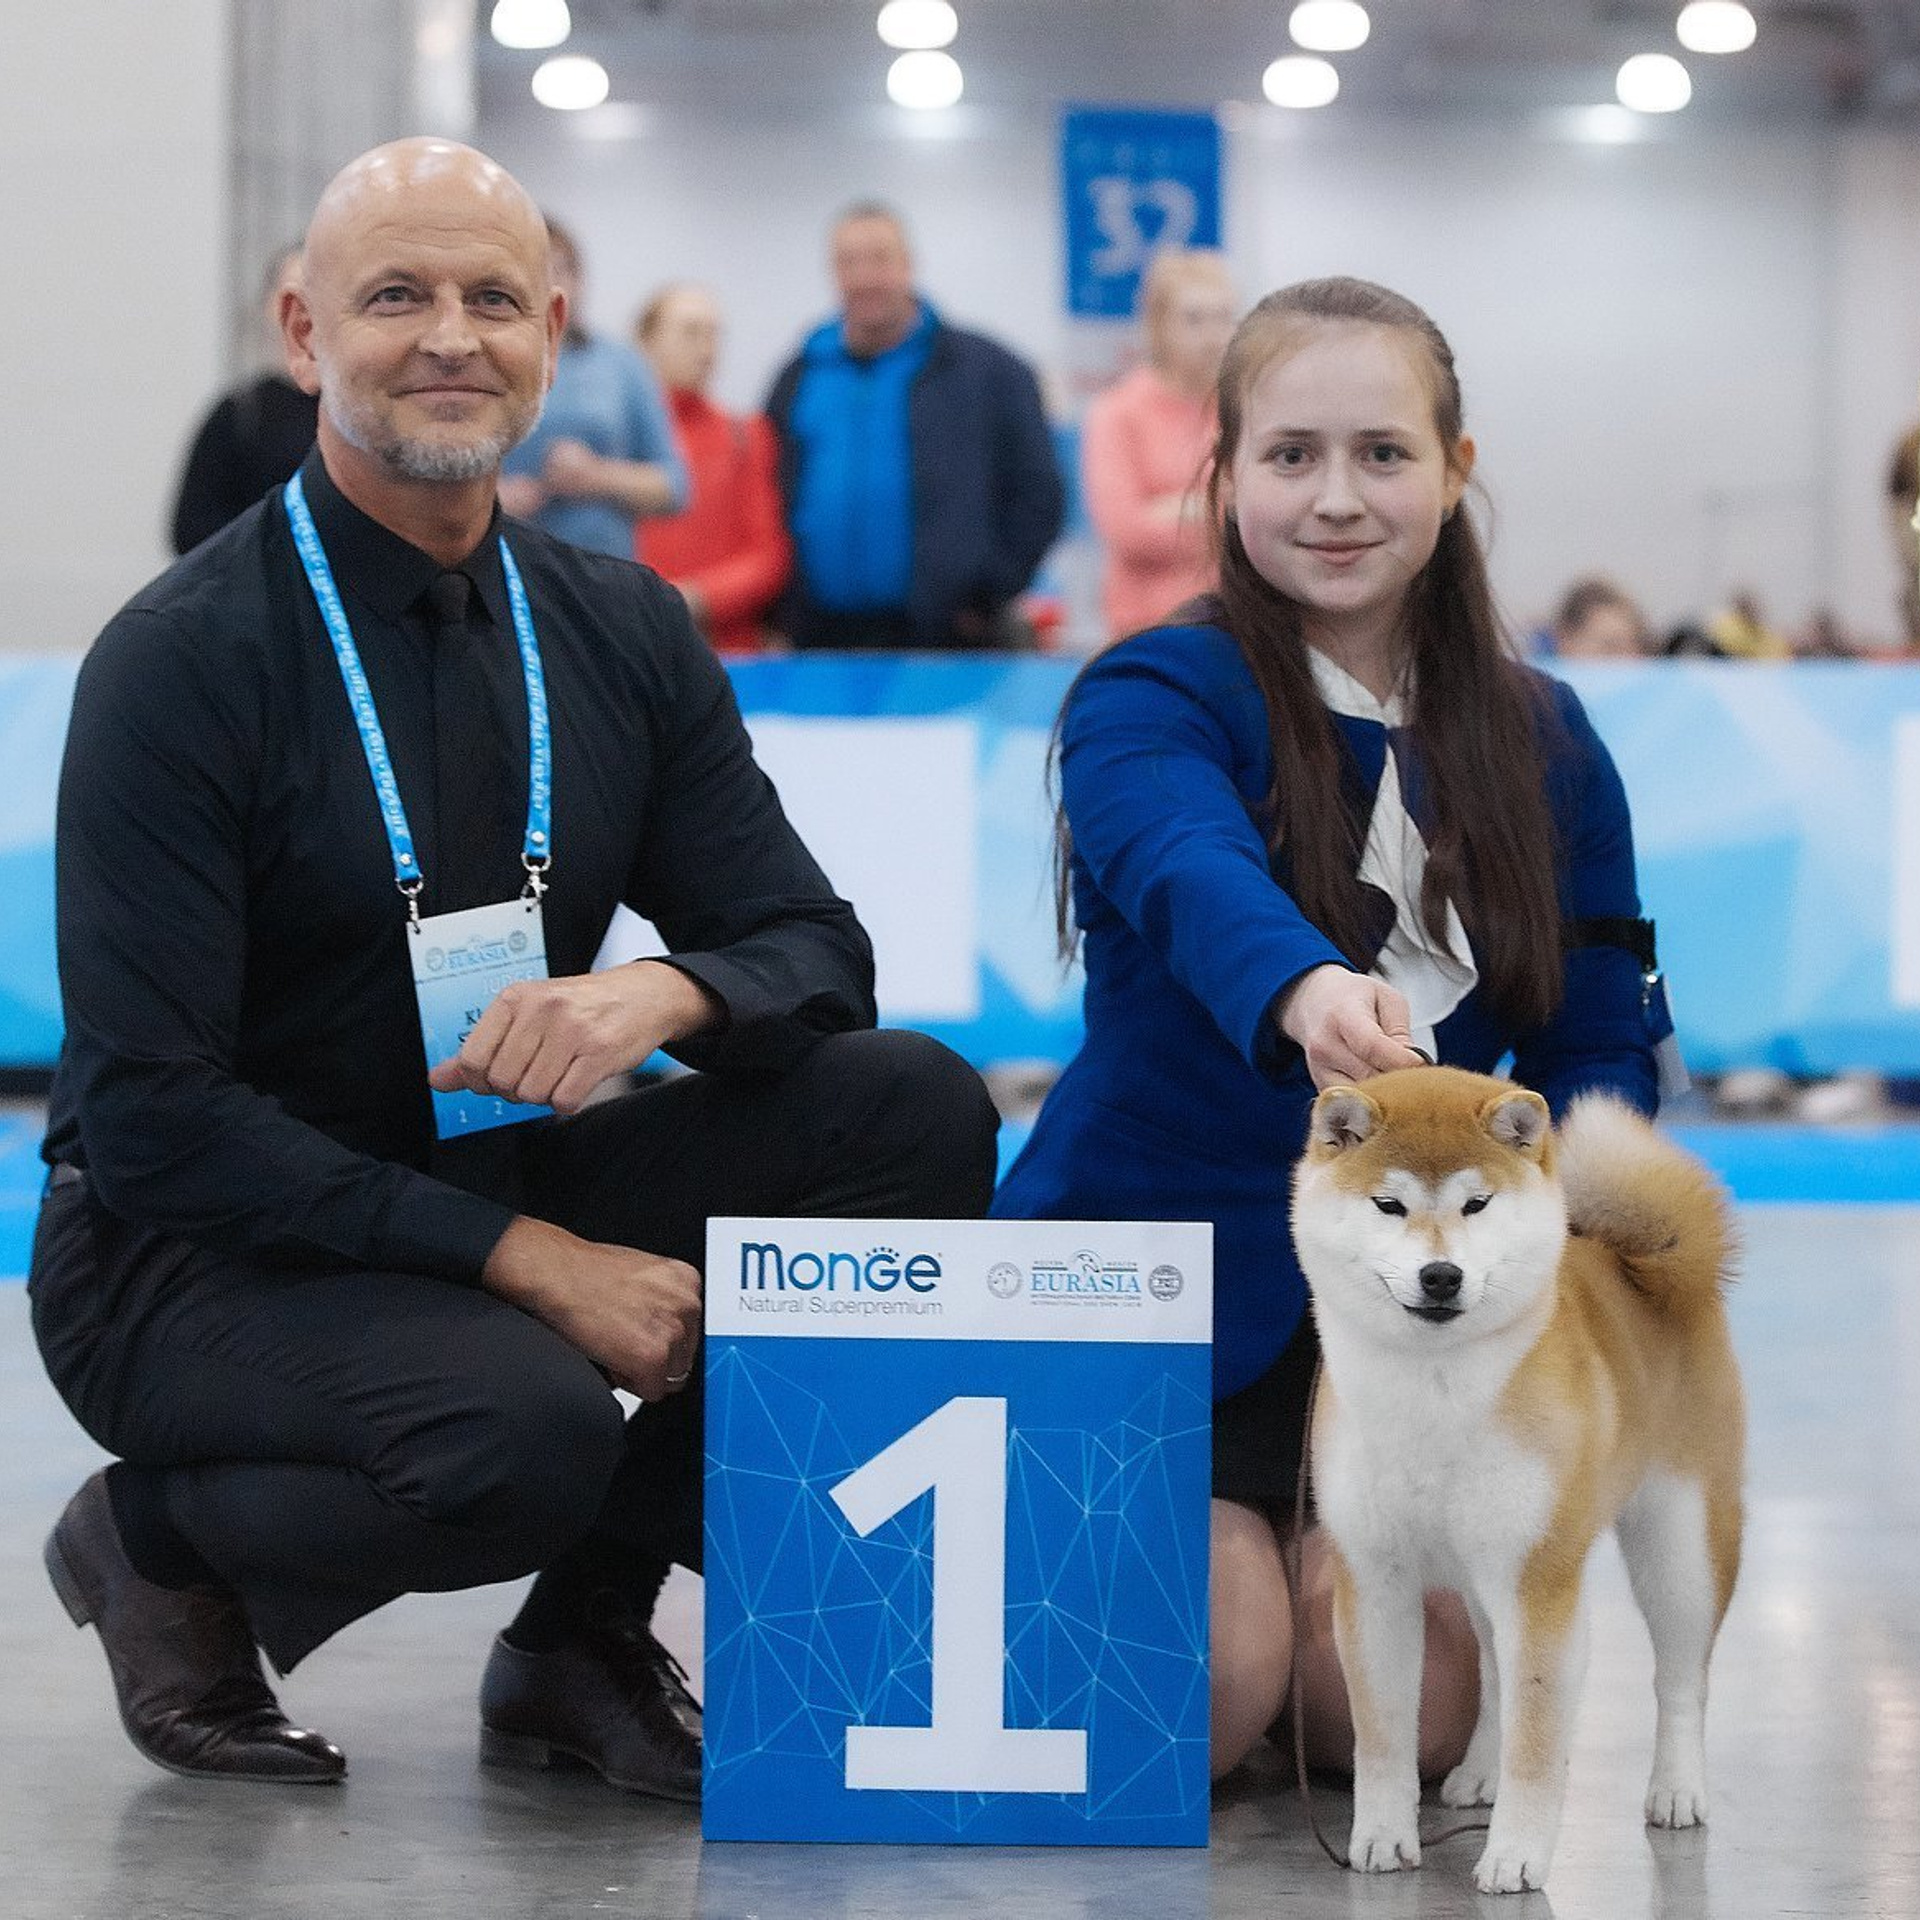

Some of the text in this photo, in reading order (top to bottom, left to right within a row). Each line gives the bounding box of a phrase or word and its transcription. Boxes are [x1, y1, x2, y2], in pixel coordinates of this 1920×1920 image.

[1031, 1272, 1141, 1293] EURASIA
[739, 1295, 943, 1316] Natural Superpremium
[828, 1396, 1087, 1794] 1
